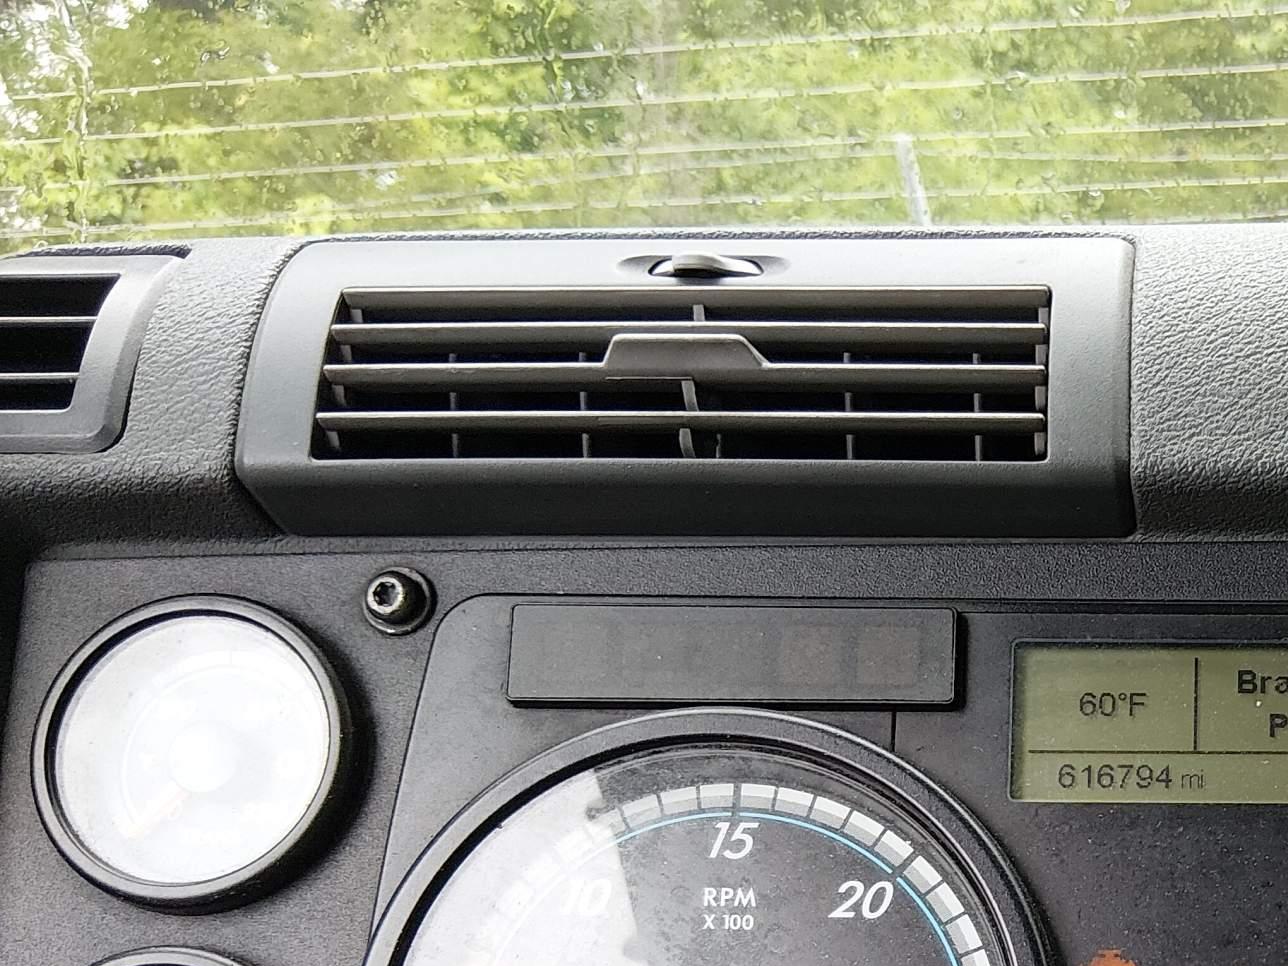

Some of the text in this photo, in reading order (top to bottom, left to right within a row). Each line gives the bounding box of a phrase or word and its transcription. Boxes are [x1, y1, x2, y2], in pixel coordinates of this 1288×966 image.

[1078, 692, 1147, 717] 60°F
[1058, 763, 1205, 790] 616794 mi
[708, 820, 758, 859] 15
[703, 886, 756, 908] RPM
[828, 879, 894, 919] 20
[703, 914, 754, 931] X 100
